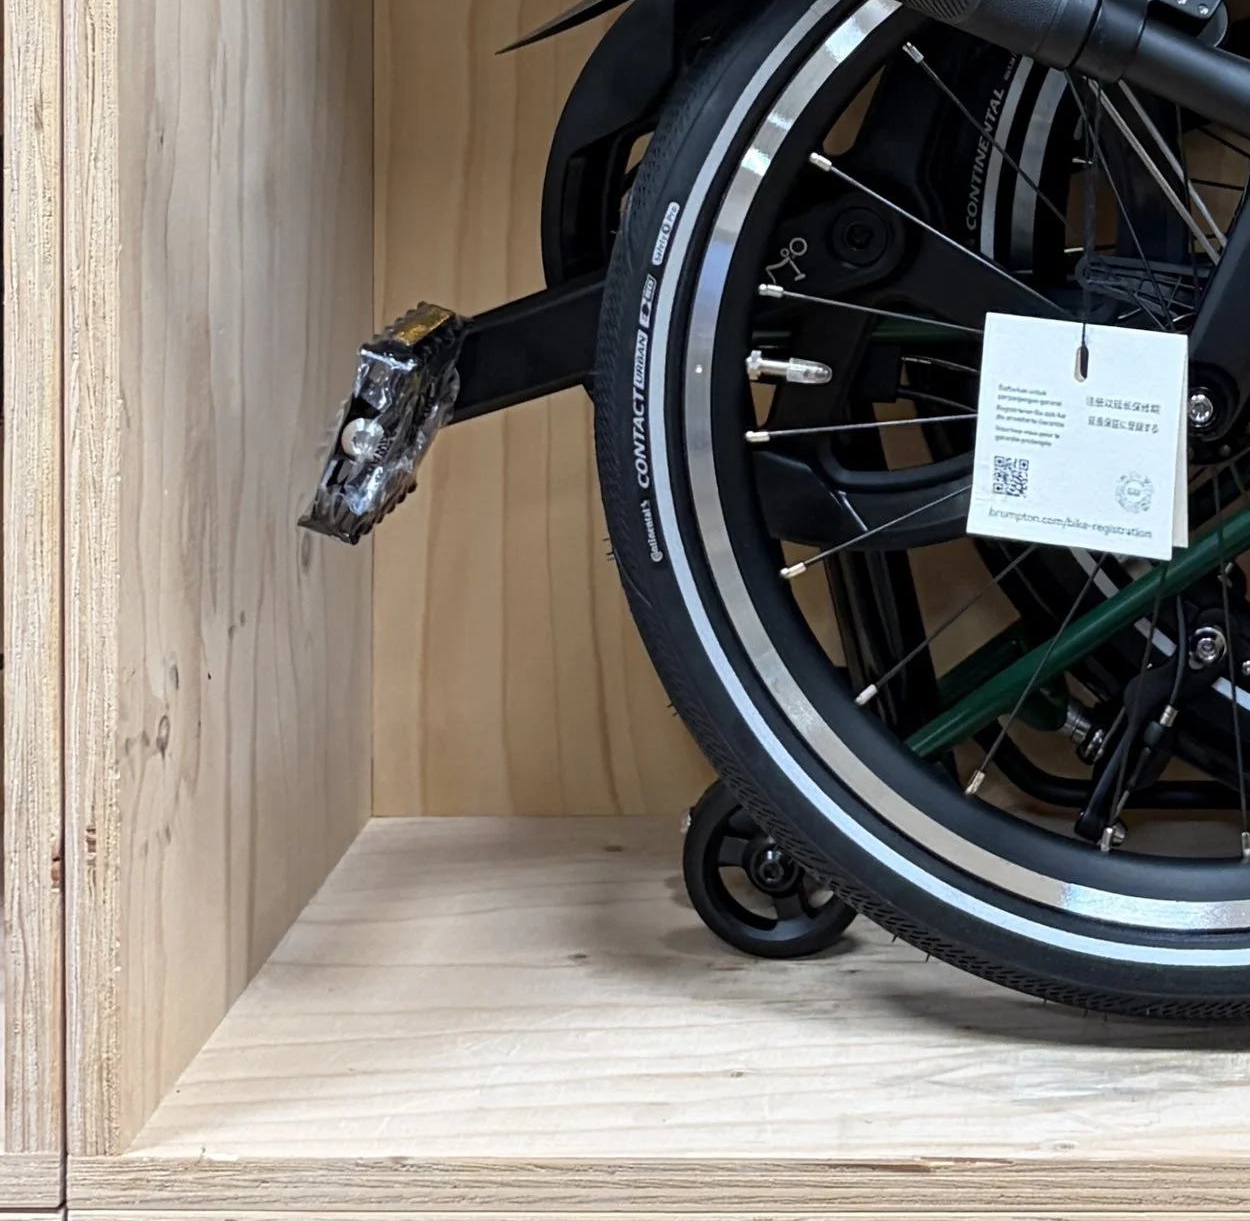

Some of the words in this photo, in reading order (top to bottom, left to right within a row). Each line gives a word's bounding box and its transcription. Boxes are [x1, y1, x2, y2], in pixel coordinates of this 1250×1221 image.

[965, 88, 1004, 231] CONTINENTAL
[636, 335, 648, 385] URBAN
[632, 388, 649, 488] CONTACT
[642, 508, 663, 563] Continental
[988, 506, 1152, 539] brompton.com/bike-registration
